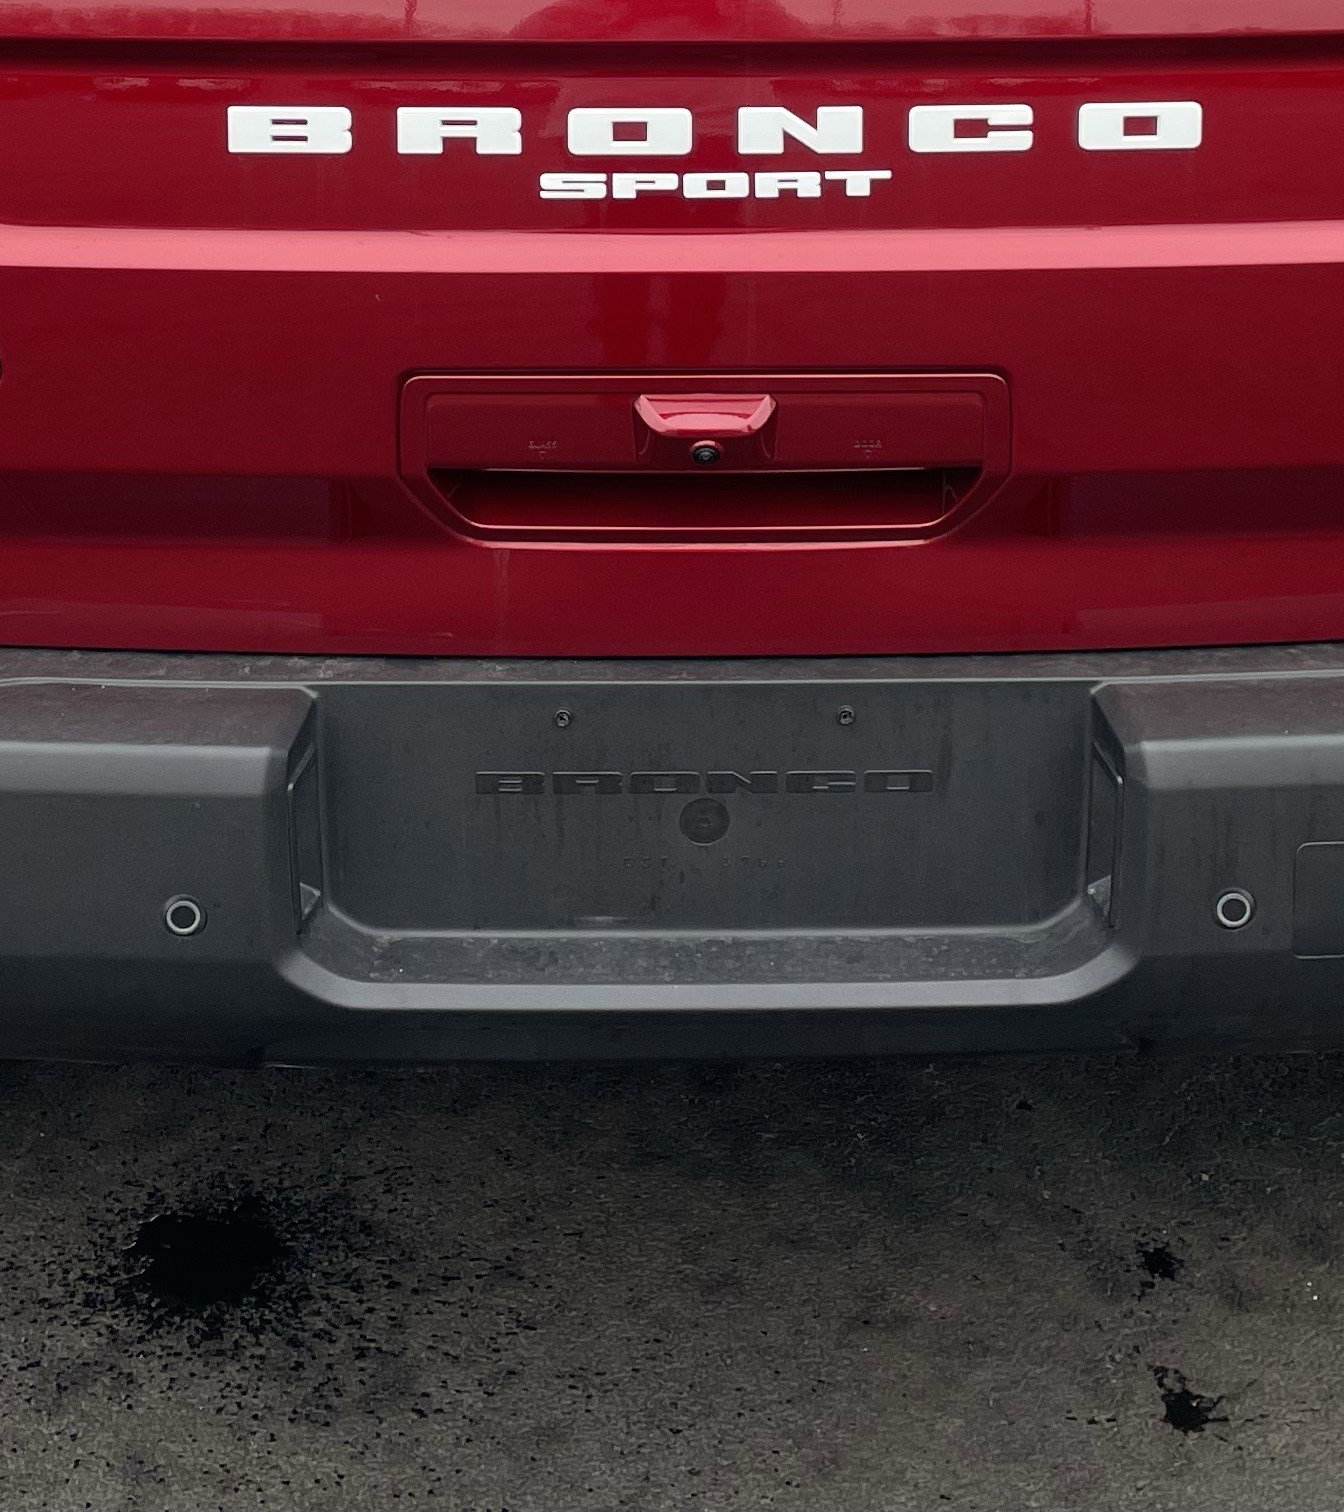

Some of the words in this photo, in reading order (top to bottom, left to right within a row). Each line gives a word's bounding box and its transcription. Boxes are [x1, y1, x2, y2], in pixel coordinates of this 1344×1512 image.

[227, 101, 1203, 155] BRONCO
[539, 170, 893, 200] SPORT
[475, 769, 933, 795] BRONCO
